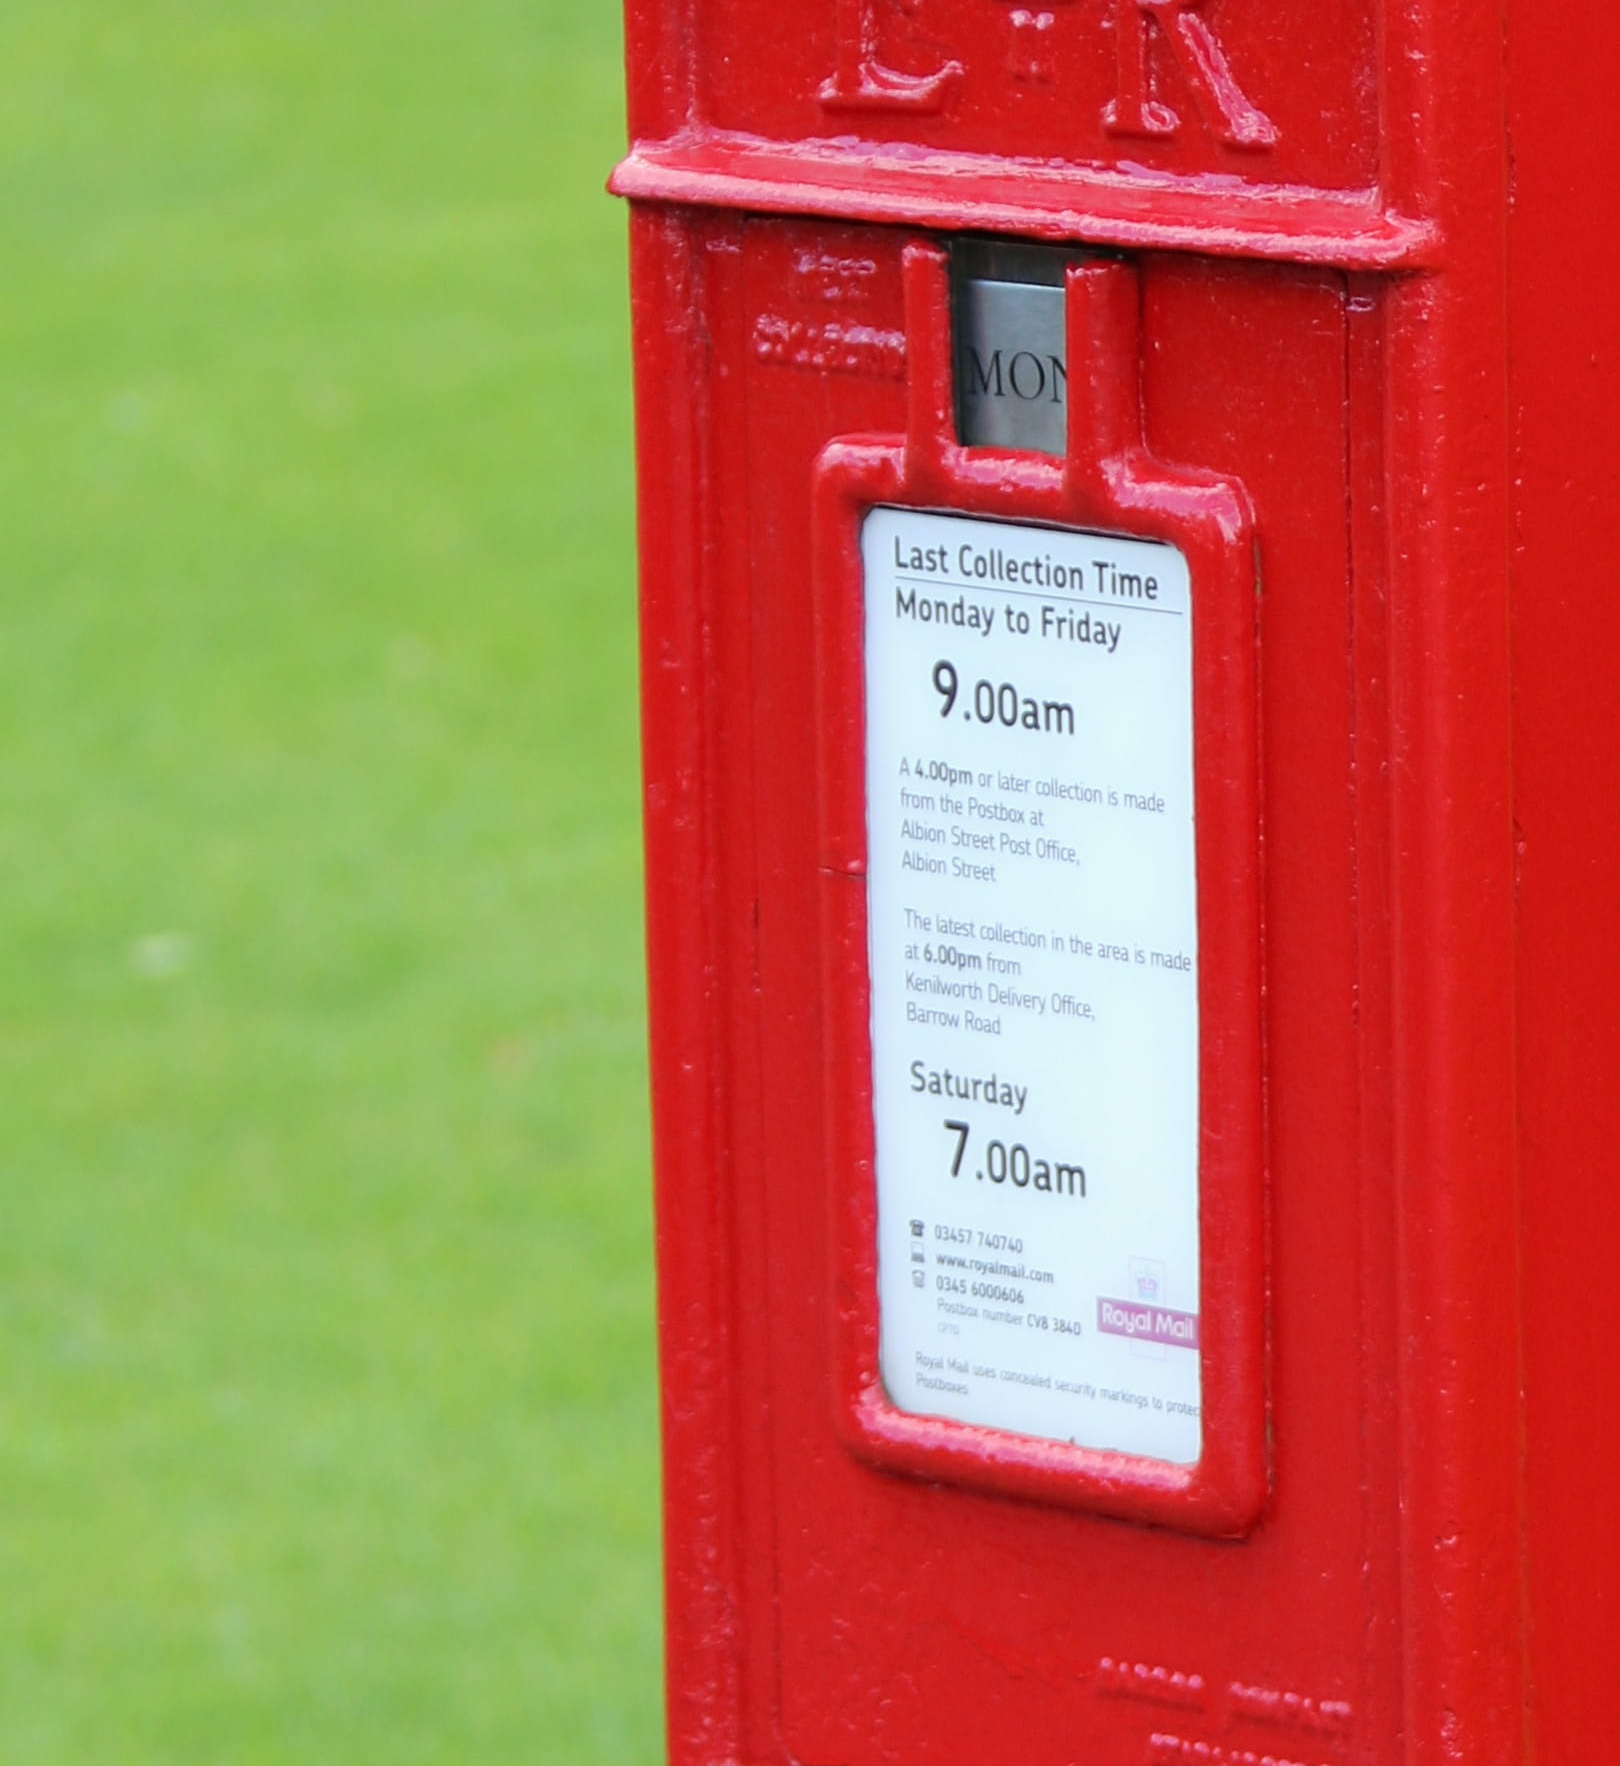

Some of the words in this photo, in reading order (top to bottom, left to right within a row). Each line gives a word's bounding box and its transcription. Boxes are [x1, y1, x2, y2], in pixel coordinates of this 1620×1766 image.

[894, 537, 948, 574] Last
[958, 544, 1083, 591] Collection
[1092, 562, 1158, 599] Time
[895, 587, 995, 637] Monday
[1006, 605, 1029, 634] to
[1042, 607, 1121, 653] Friday
[932, 660, 1074, 734] 9.00am
[899, 756, 910, 777] A
[914, 760, 973, 786] 4.00pm
[978, 771, 993, 787] or
[998, 770, 1030, 794] later
[1035, 776, 1102, 804] collection
[1107, 787, 1119, 806] is
[1123, 787, 1166, 813] made
[900, 788, 935, 811] from
[940, 795, 963, 815] the
[968, 798, 1024, 823] Postbox
[1030, 809, 1044, 827] at
[901, 820, 946, 843] Albion
[951, 826, 995, 851] Street
[1000, 834, 1031, 856] Post
[1036, 837, 1080, 864] Office,
[901, 850, 946, 874] Albion
[952, 857, 996, 881] Street
[904, 908, 931, 931] The
[936, 913, 975, 938] latest
[980, 921, 1046, 948] collection
[1052, 930, 1064, 951] in
[1070, 935, 1093, 956] the
[1098, 943, 1128, 962] area
[1134, 944, 1145, 965] is
[1150, 947, 1192, 971] made
[905, 942, 919, 961] at
[923, 943, 982, 970] 6.00pm
[986, 952, 1021, 975] from
[906, 971, 983, 1001] Kenilworth
[988, 984, 1046, 1014] Delivery
[1051, 993, 1096, 1021] Office,
[907, 1002, 959, 1027] Barrow
[965, 1011, 1001, 1035] Road
[910, 1060, 1028, 1116] Saturday
[943, 1119, 1087, 1198] 7.00am
[934, 1224, 972, 1244] 03457
[978, 1231, 1023, 1254] 740740
[936, 1254, 1054, 1284] www.royalmail.com
[936, 1275, 966, 1295] 0345
[971, 1282, 1024, 1304] 6000606
[937, 1299, 979, 1318] Postbox
[982, 1307, 1025, 1326] number
[1026, 1309, 1049, 1330] CV8
[1102, 1303, 1152, 1335] Royal
[1155, 1313, 1195, 1339] Mail
[916, 1351, 944, 1369] Royal
[947, 1358, 969, 1373] Mail
[1000, 1368, 1052, 1389] concealed
[1055, 1377, 1096, 1399] security
[1100, 1386, 1149, 1409] markings
[1152, 1395, 1163, 1409] to
[916, 1374, 968, 1395] Postboxes
